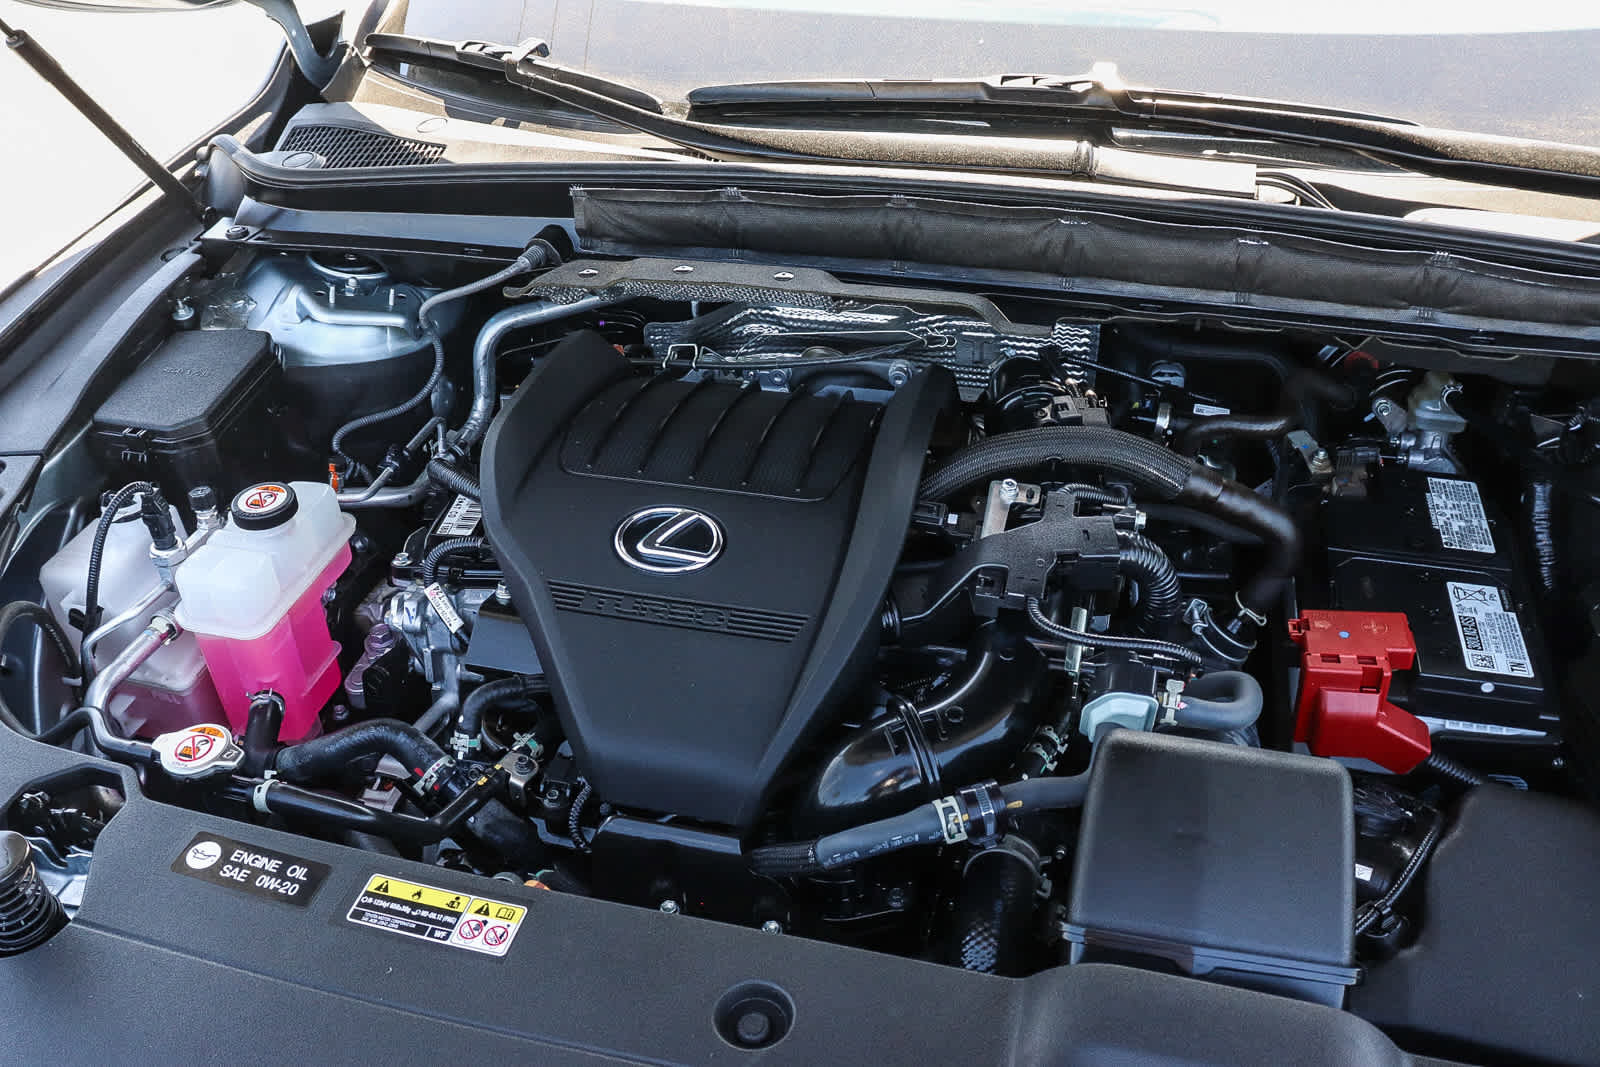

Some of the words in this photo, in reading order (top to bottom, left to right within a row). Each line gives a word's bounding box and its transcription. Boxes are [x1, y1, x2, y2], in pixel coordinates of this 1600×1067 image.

[219, 864, 251, 883] SAE
[255, 874, 300, 896] 0W-20
[230, 849, 282, 873] ENGINE
[286, 864, 308, 881] OIL
